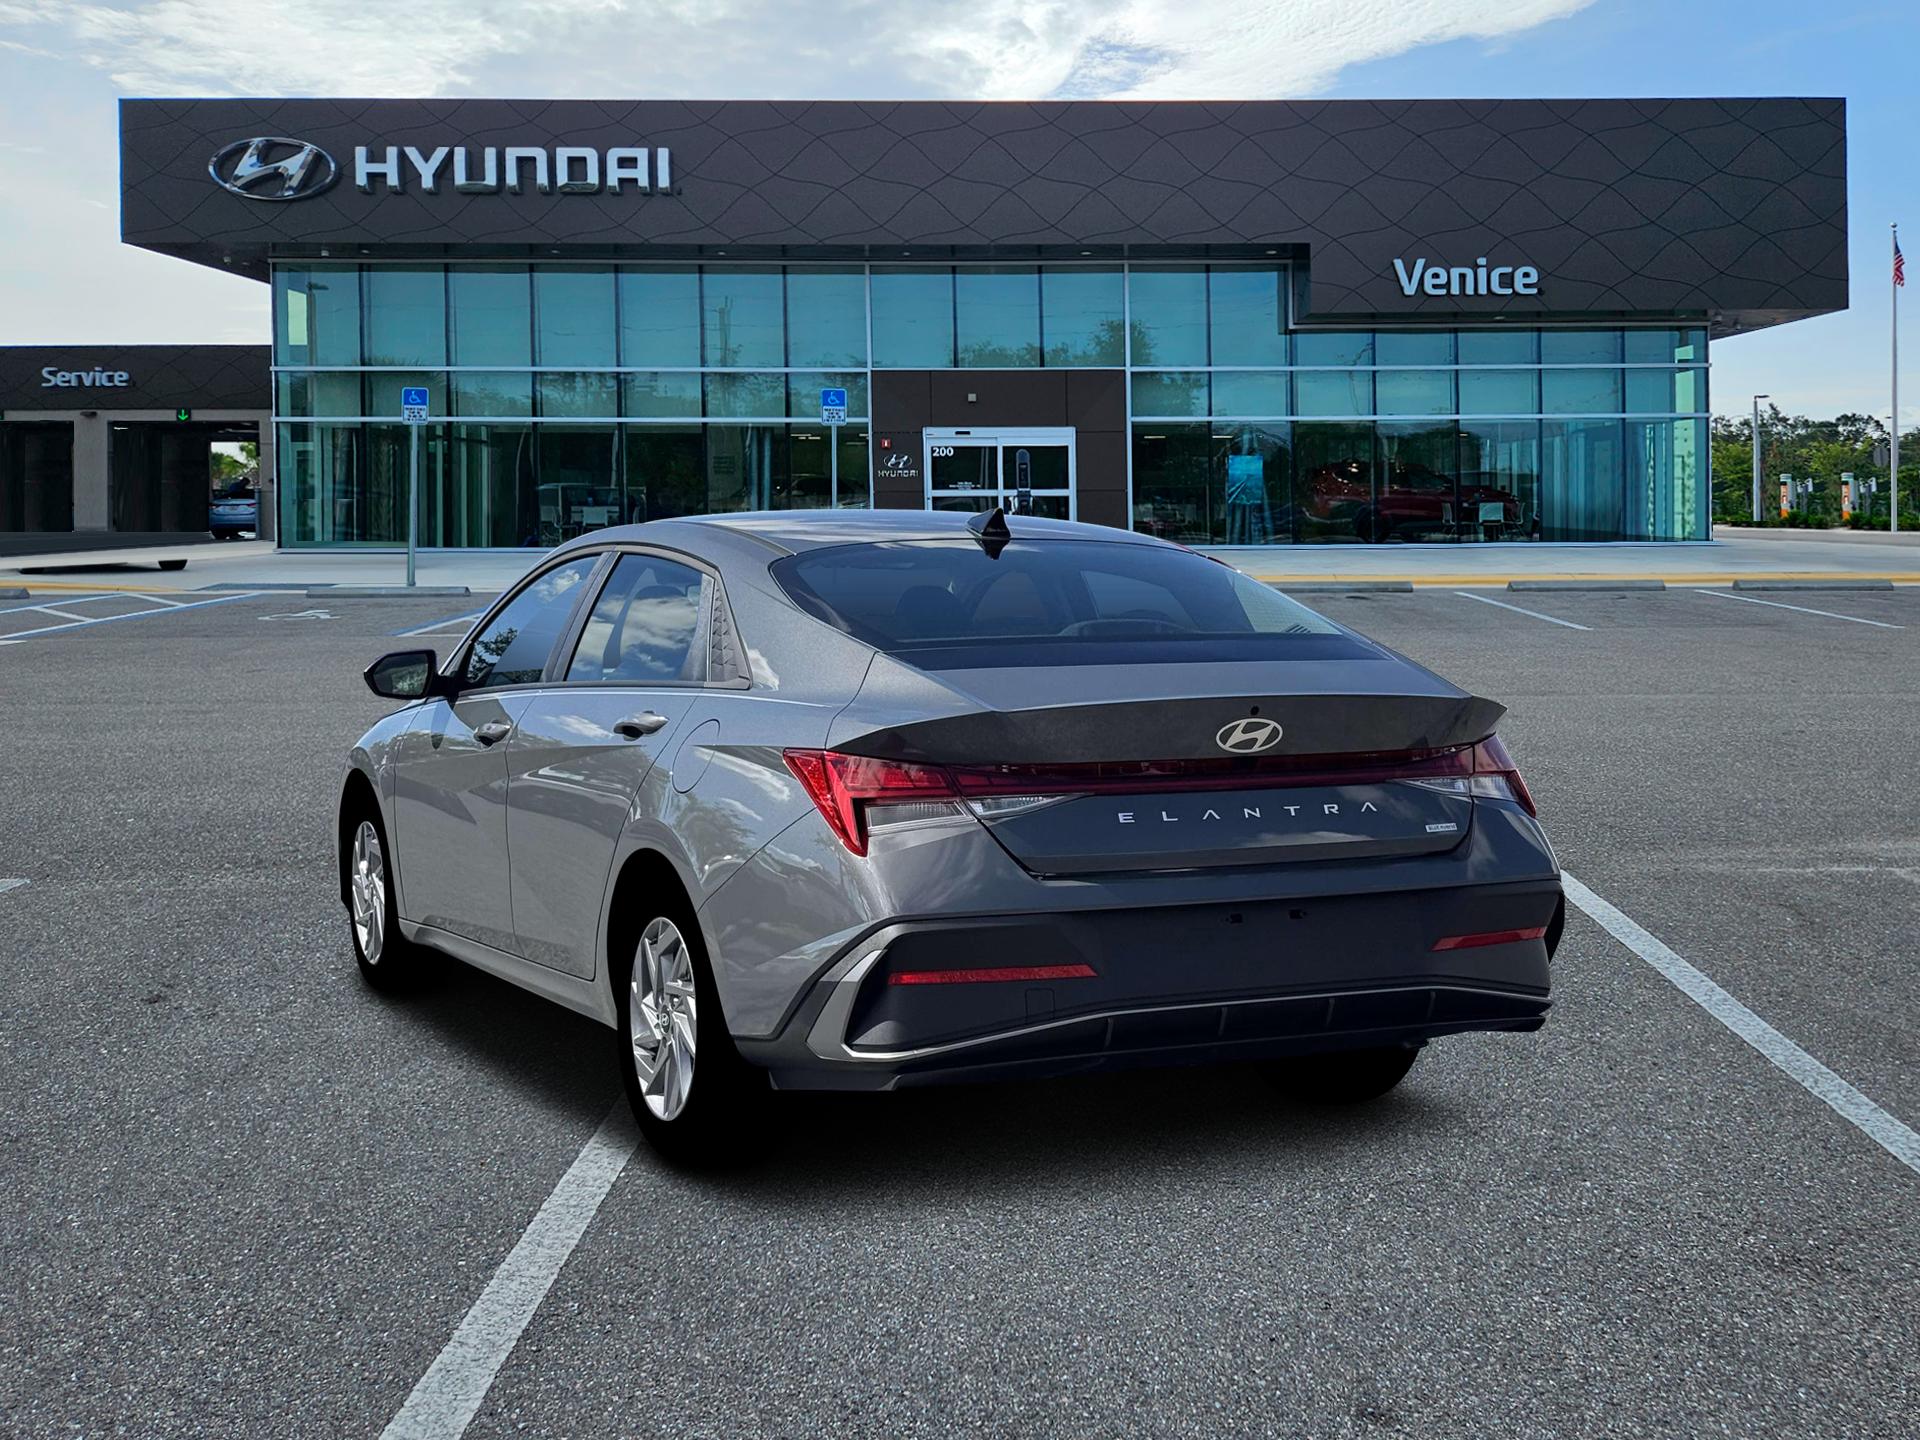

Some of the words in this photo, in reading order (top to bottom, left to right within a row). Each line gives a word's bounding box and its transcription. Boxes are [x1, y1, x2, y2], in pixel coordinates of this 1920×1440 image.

[355, 146, 671, 193] HYUNDAI
[1393, 257, 1539, 295] Venice
[41, 366, 129, 387] Service
[932, 447, 954, 457] 200
[1118, 801, 1377, 823] ELANTRA
